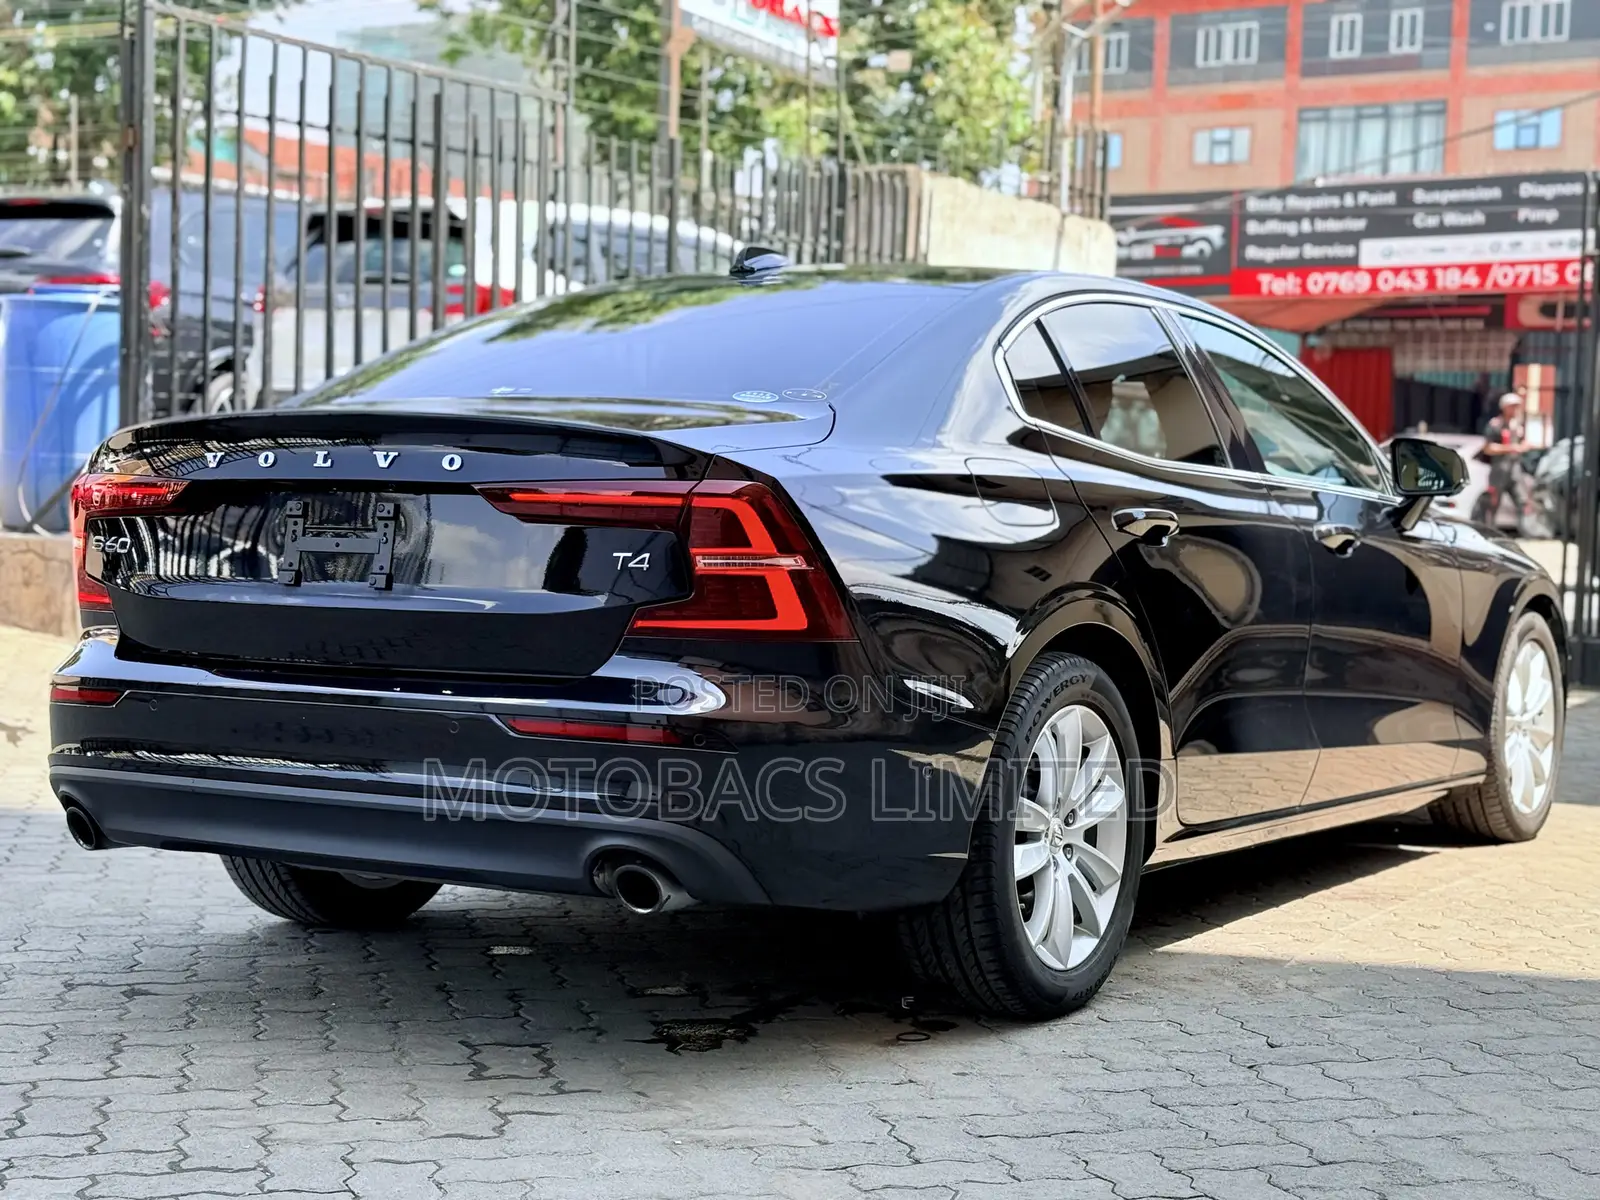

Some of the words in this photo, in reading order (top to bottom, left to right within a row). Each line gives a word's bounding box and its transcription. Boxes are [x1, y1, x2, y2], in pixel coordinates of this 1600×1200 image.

[1256, 272, 1302, 296] Tel:
[1306, 271, 1372, 294] 0769
[1376, 268, 1428, 293] 043
[1432, 265, 1481, 290] 184
[204, 450, 464, 471] VOLVO
[91, 535, 131, 554] S60
[612, 552, 651, 571] T4
[1024, 673, 1089, 745] POWERGY
